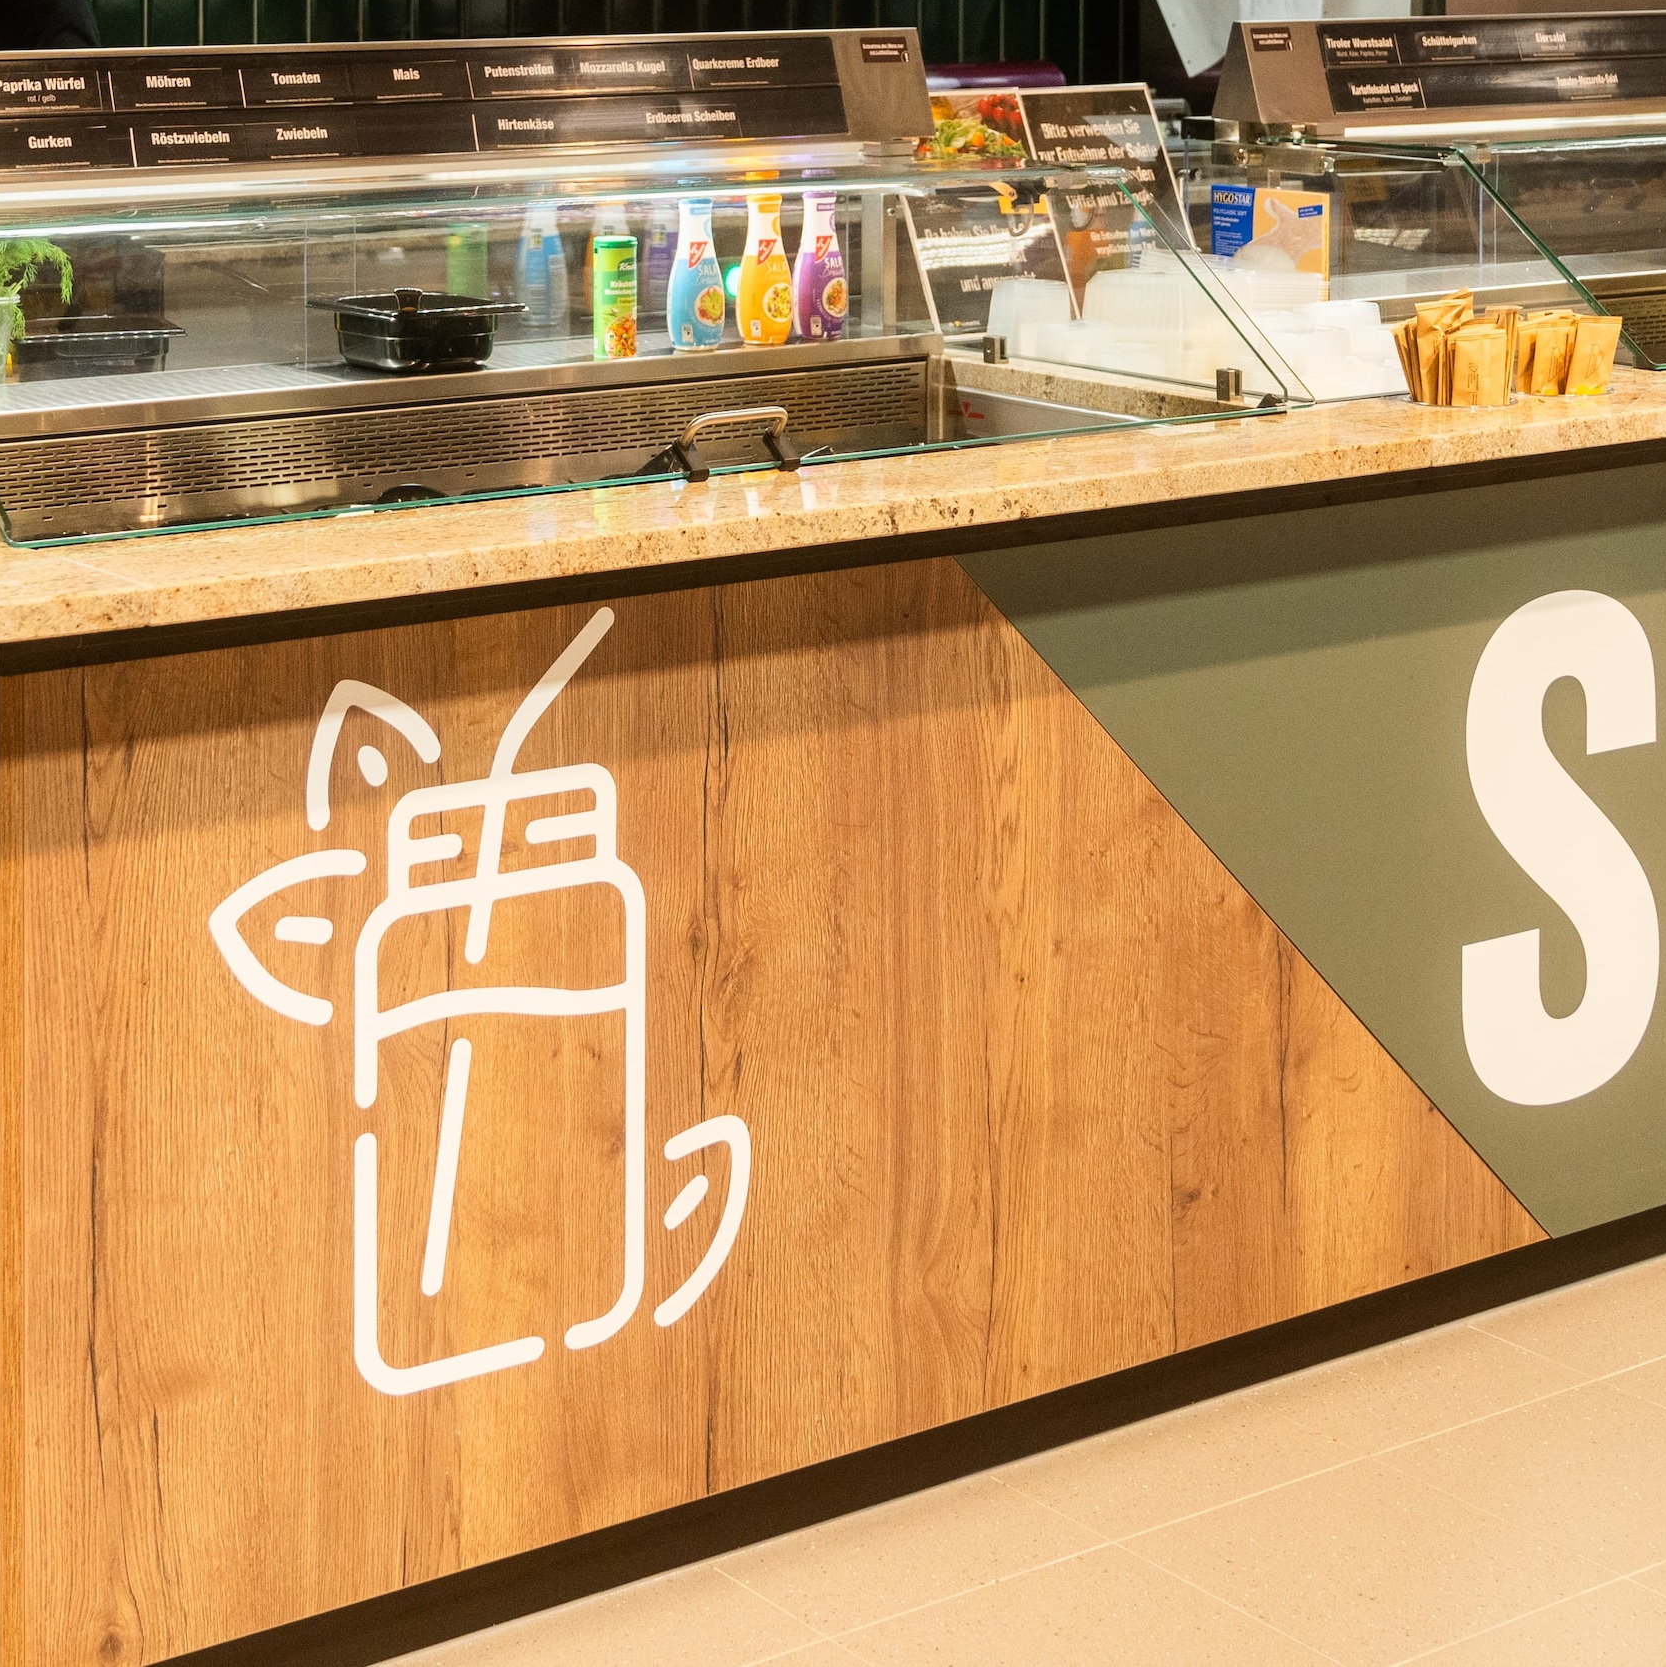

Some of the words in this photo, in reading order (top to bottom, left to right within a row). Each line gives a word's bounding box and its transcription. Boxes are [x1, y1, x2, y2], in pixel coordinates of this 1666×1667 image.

[1325, 37, 1351, 49] Tiroler
[1352, 36, 1393, 49] Wurstsalat
[1421, 35, 1477, 48] Schüttelgurken
[1535, 32, 1567, 43] Eiersalat
[579, 61, 635, 74] Mozzarella
[636, 60, 666, 74] Kugel
[692, 57, 745, 71] Quarkcreme
[746, 56, 780, 68] Erdbeer
[393, 67, 421, 81] Mais
[484, 64, 555, 78] Putenstreifen
[44, 76, 86, 91] Würfel
[146, 74, 191, 89] Möhren
[271, 71, 322, 86] Tomaten
[1350, 83, 1390, 96] Kartoffelsalat
[1390, 83, 1400, 94] mit
[1400, 82, 1419, 95] Speck
[27, 95, 37, 103] rot
[42, 93, 57, 104] gelb
[646, 112, 693, 124] Erdbeeren
[693, 110, 736, 123] Scheiben
[497, 118, 555, 131] Hirtenkäse
[1040, 122, 1068, 140] Bitte
[1067, 120, 1124, 138] verwenden
[1123, 118, 1141, 135] Sie
[151, 130, 231, 146] Röstzwiebeln
[276, 127, 329, 141] Zwiebeln
[28, 135, 73, 149] Gurken
[1055, 144, 1108, 162] Entnahme
[1107, 142, 1125, 160] der
[960, 274, 982, 293] und
